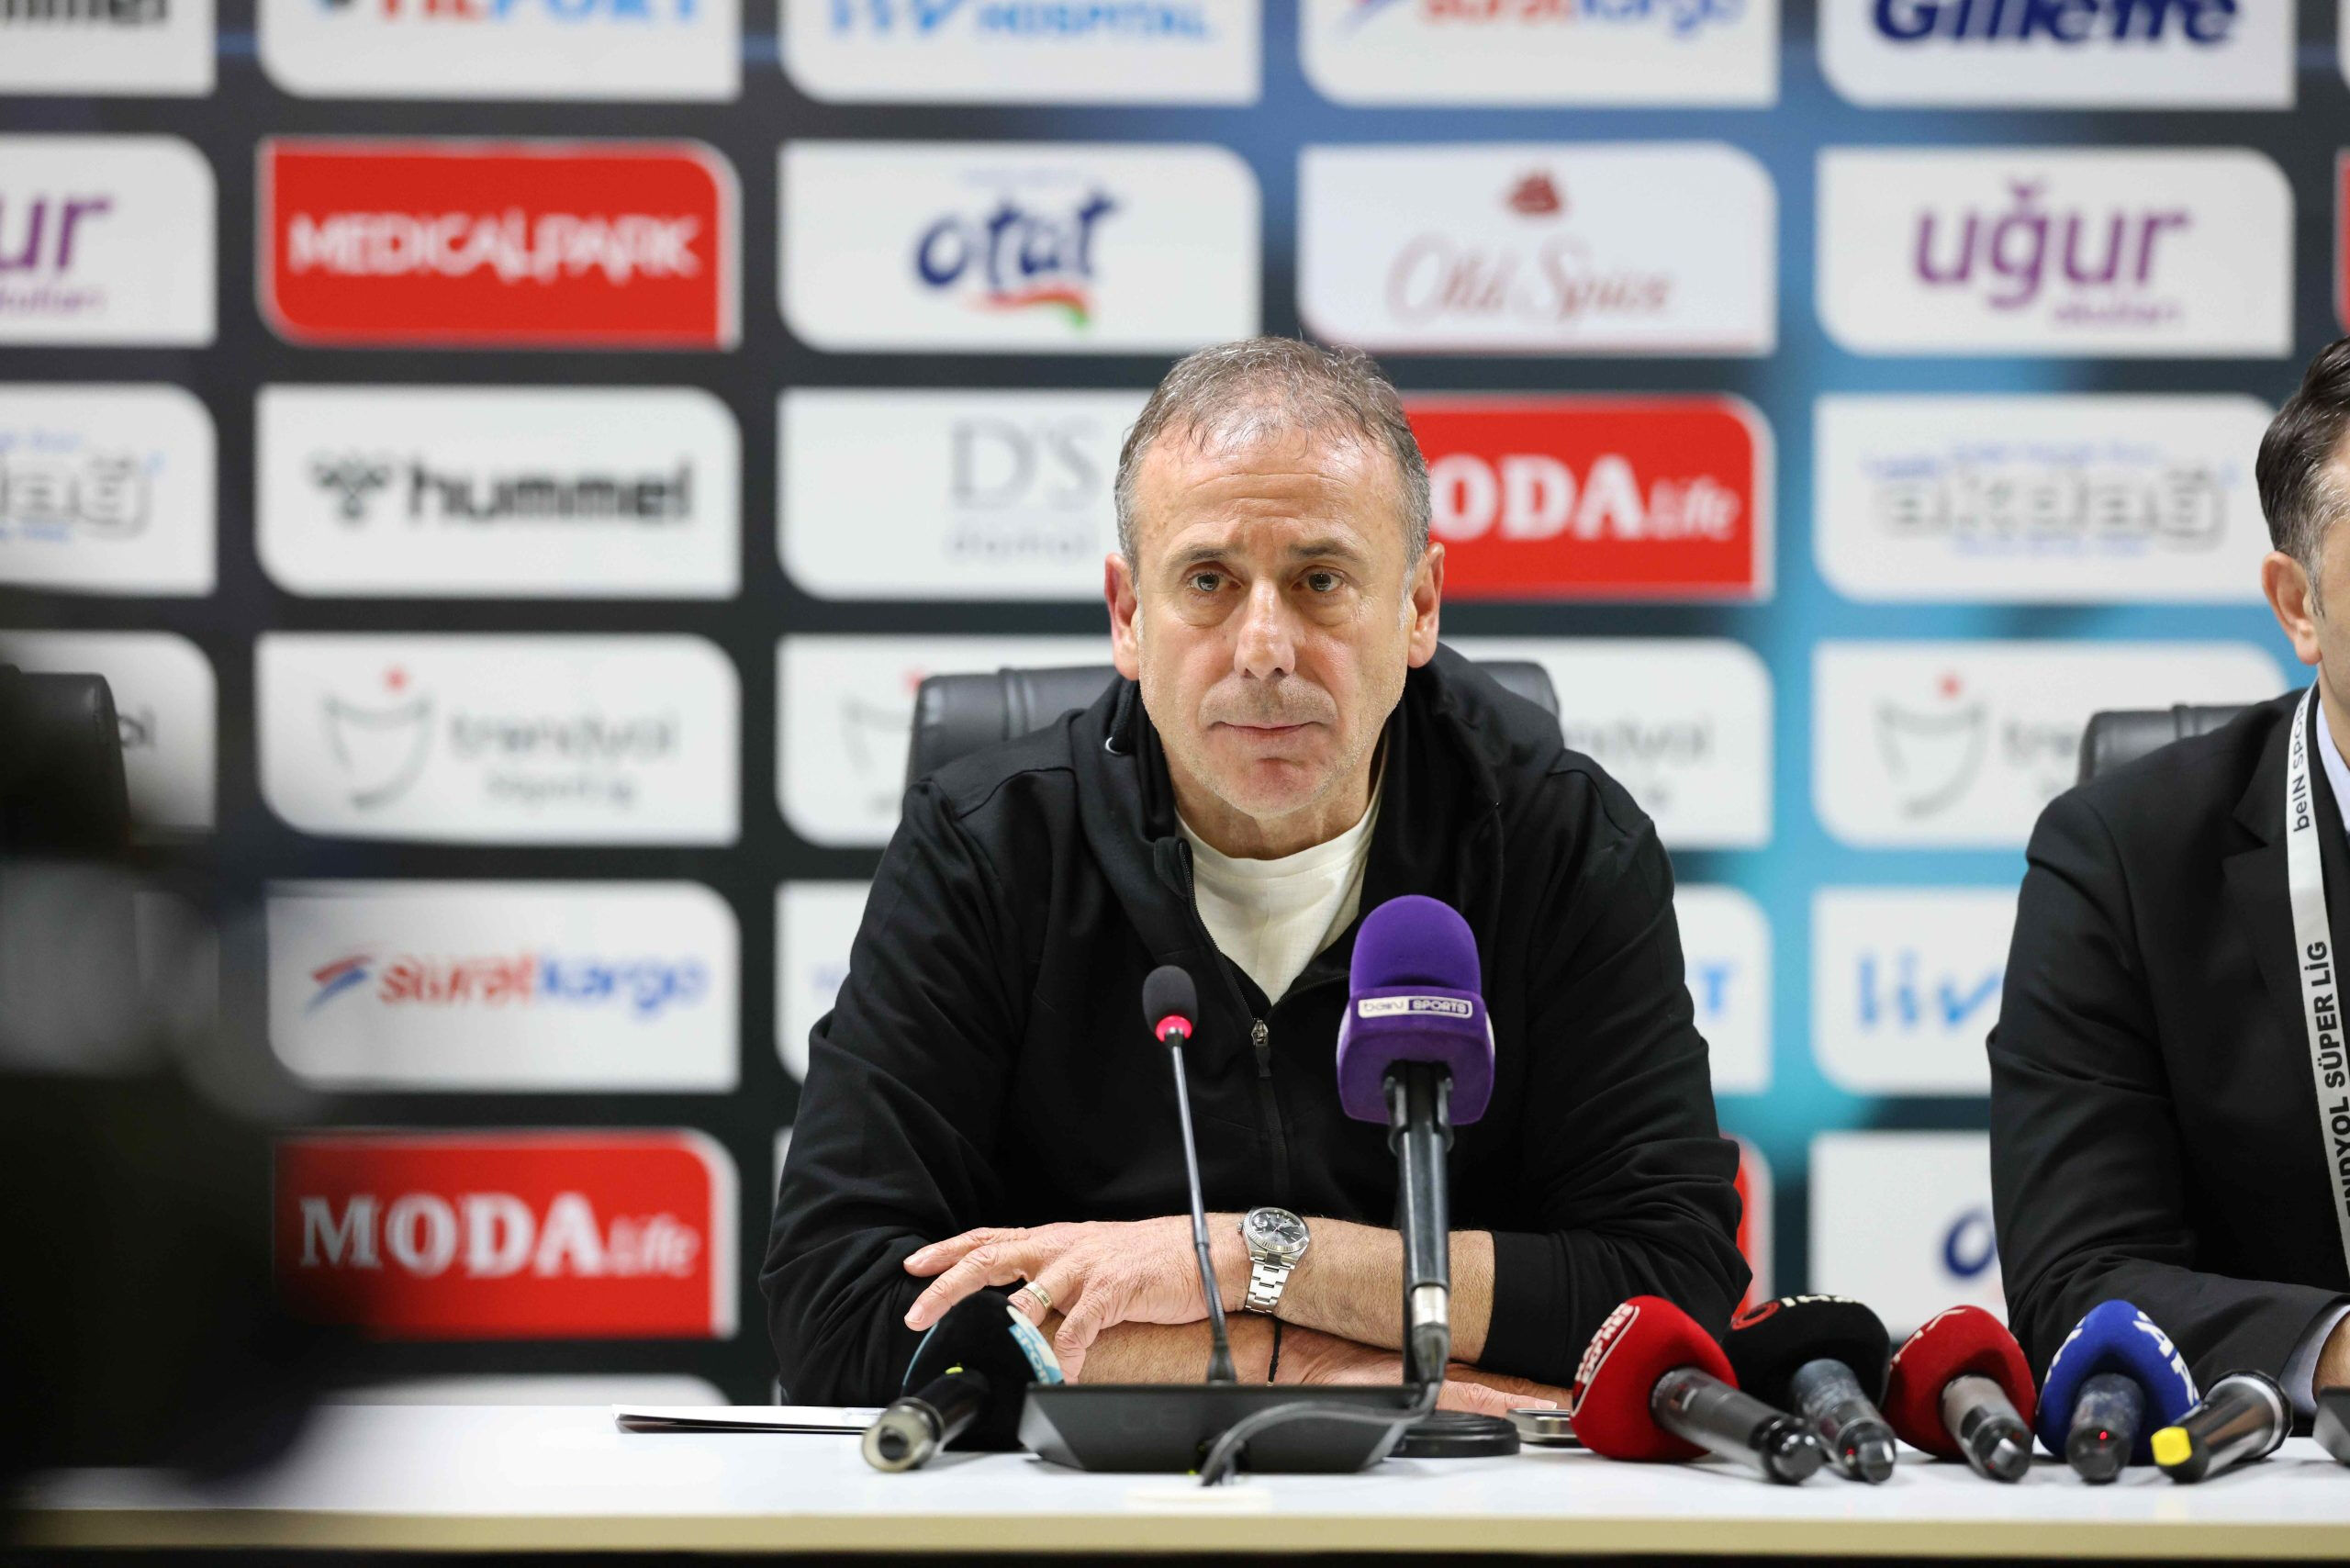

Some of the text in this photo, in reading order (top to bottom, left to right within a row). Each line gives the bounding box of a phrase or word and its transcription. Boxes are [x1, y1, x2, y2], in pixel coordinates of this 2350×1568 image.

[1384, 234, 1676, 332] Old Spice
[1912, 178, 2191, 309] uğur
[409, 456, 694, 523] hummel
[1428, 453, 1647, 542] ODA
[2293, 775, 2311, 833] beIN
[1413, 999, 1467, 1014] SPORTS
[2304, 940, 2332, 987] LİG
[2313, 993, 2346, 1089] SÜPER
[300, 1193, 607, 1279] MODA
